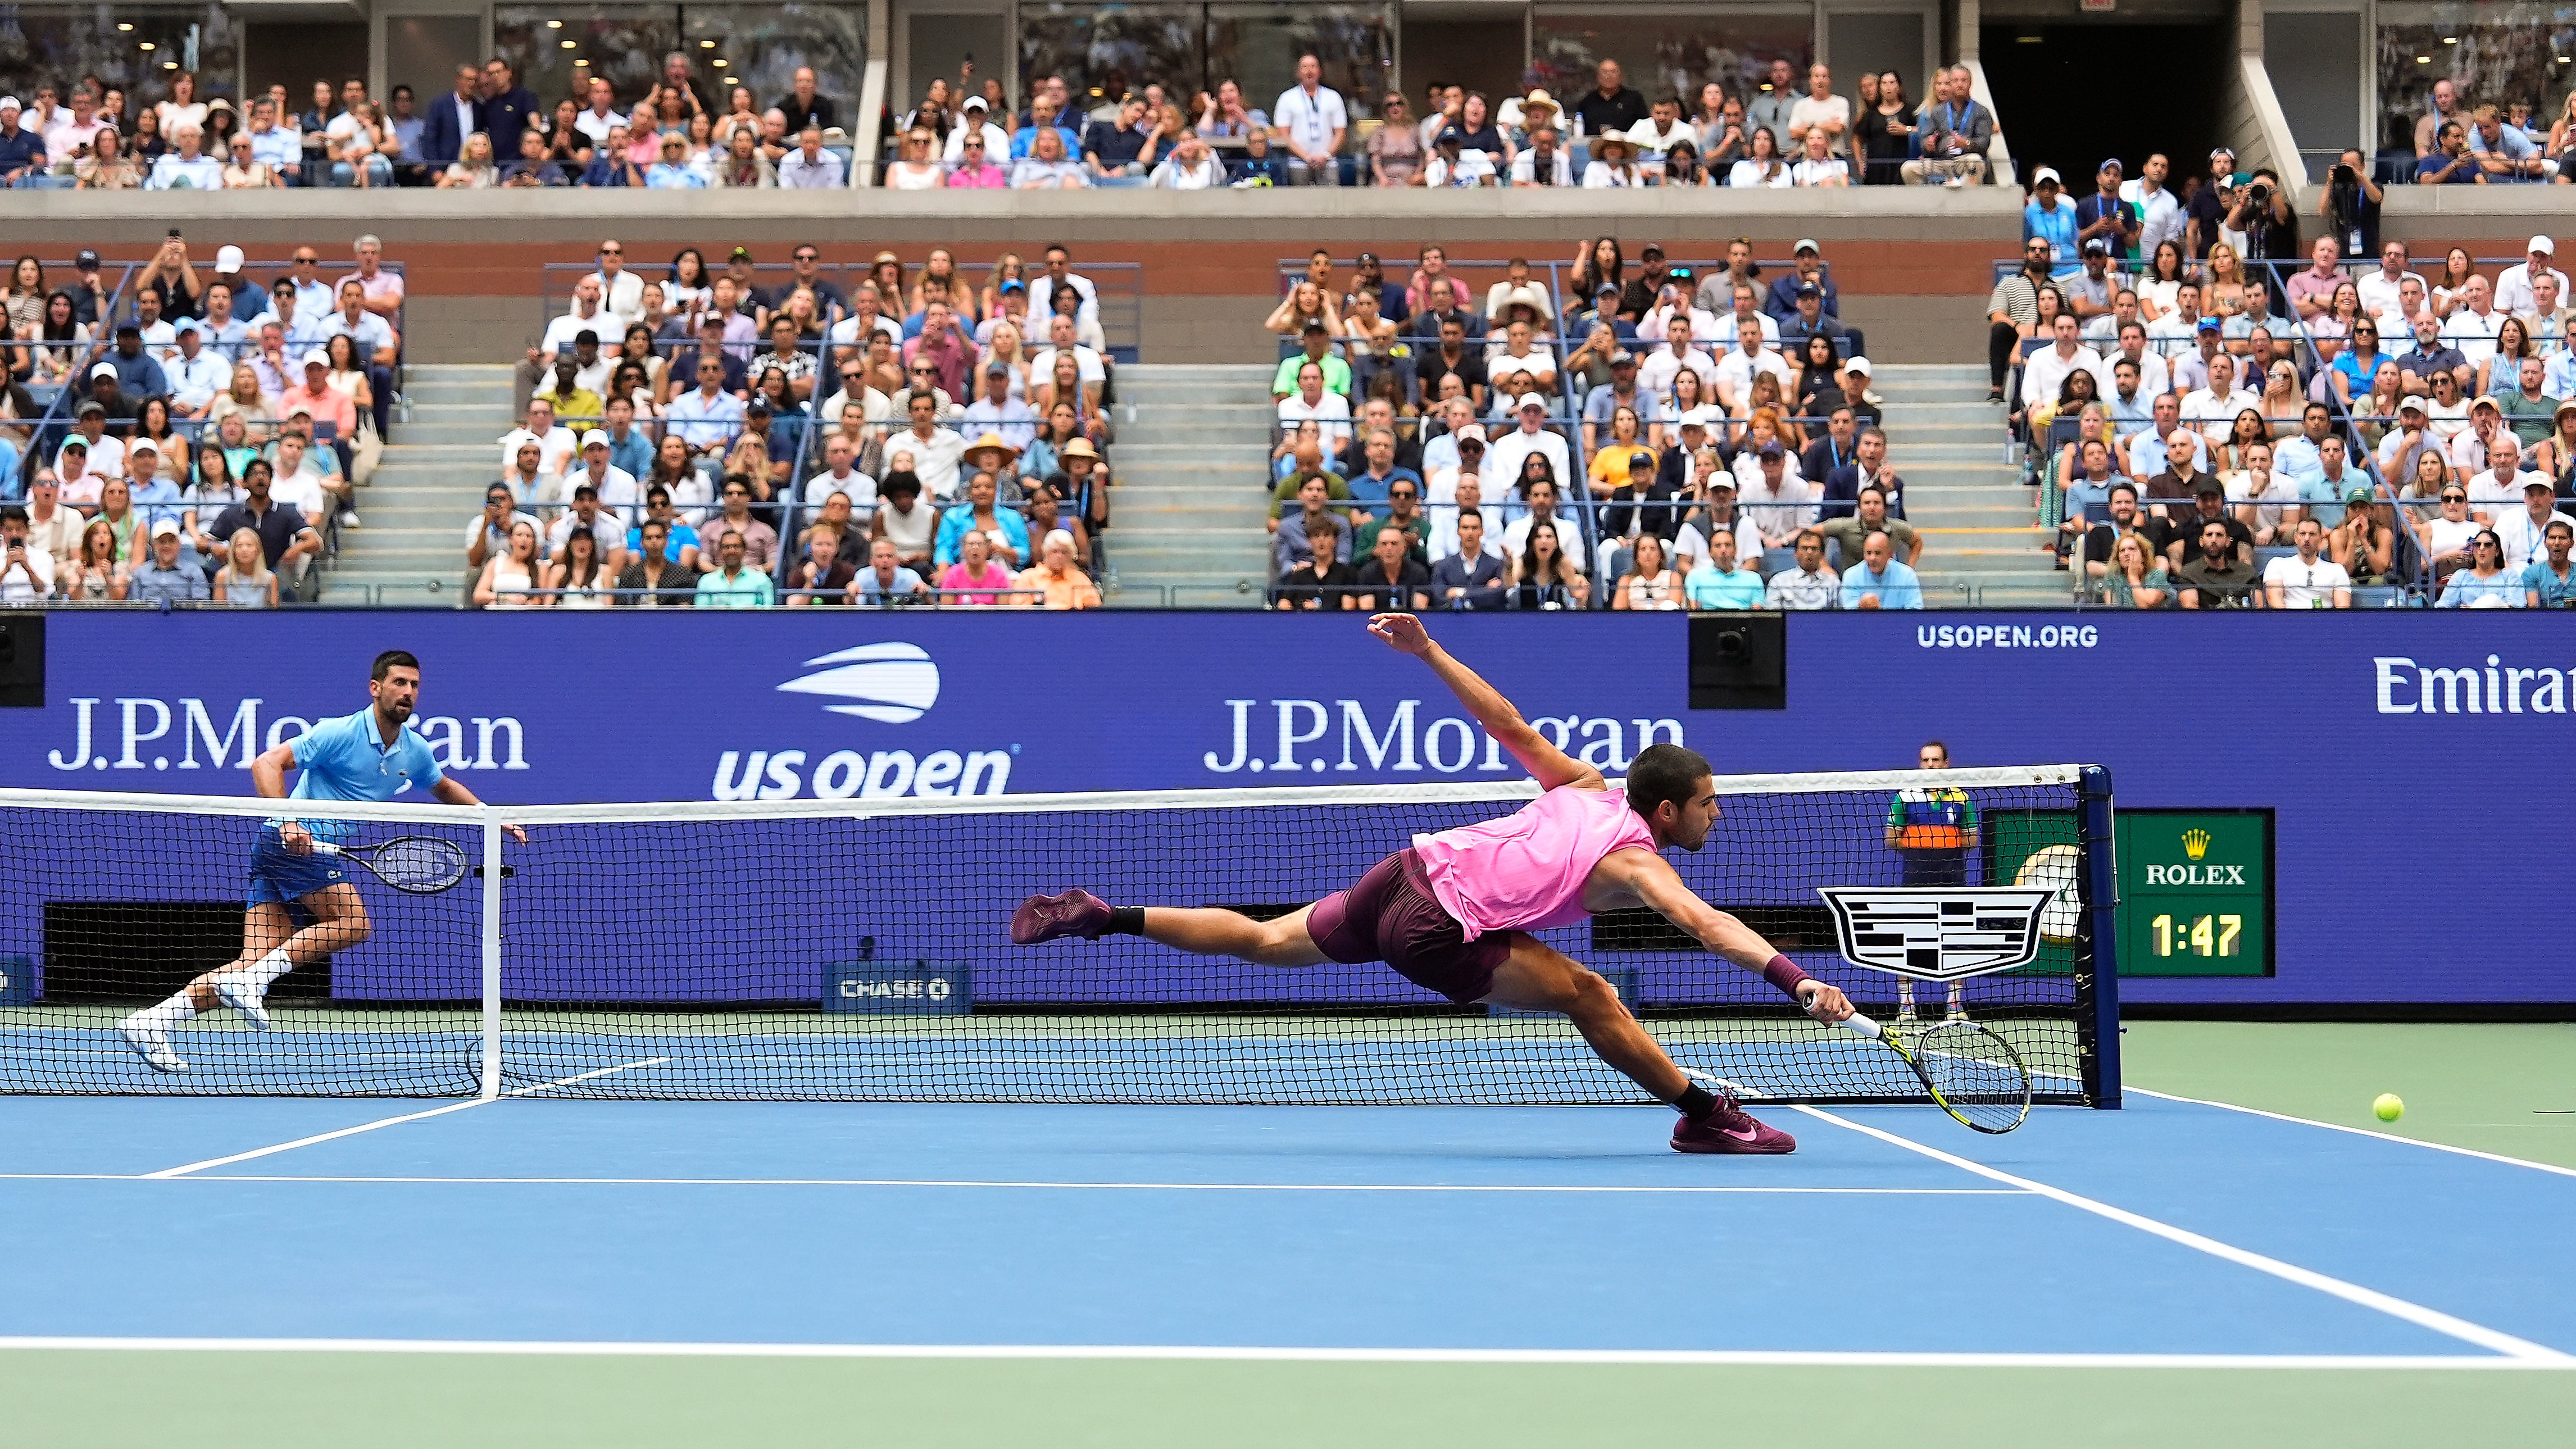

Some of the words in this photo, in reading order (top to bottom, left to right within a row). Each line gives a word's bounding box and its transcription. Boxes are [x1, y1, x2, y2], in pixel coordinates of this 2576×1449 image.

[1917, 624, 2098, 648] USOPEN.ORG
[47, 697, 531, 794] J.P.Moan
[712, 749, 807, 800] us
[811, 749, 1012, 798] open
[2146, 864, 2246, 886] ROLEX
[2152, 914, 2242, 957] 1:47
[840, 979, 925, 999] CHASE
